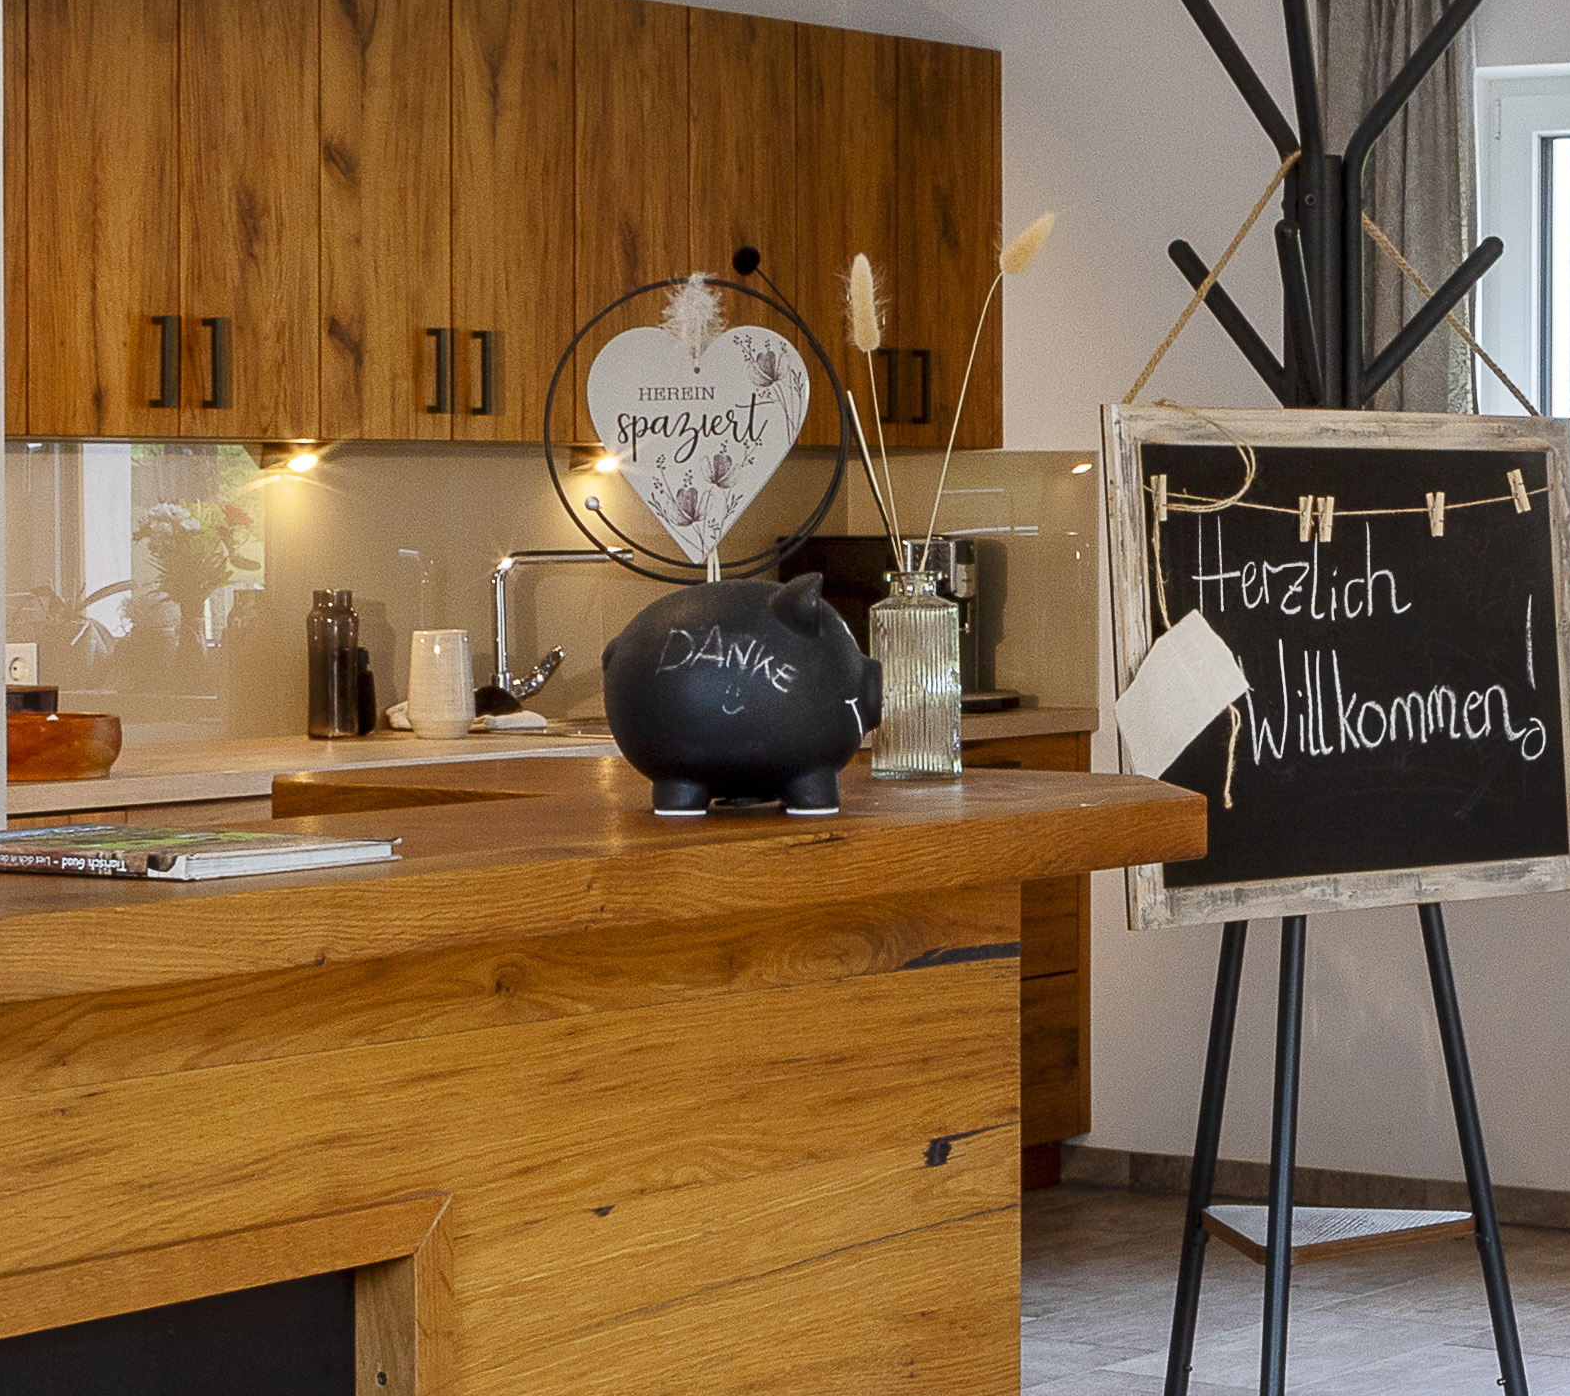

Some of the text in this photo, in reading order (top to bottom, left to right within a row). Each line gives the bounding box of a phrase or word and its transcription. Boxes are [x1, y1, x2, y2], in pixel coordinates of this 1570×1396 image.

[638, 387, 716, 401] HEREIN
[617, 393, 775, 464] spaziert
[1191, 515, 1412, 621] Herzlich
[656, 627, 798, 693] DANKE
